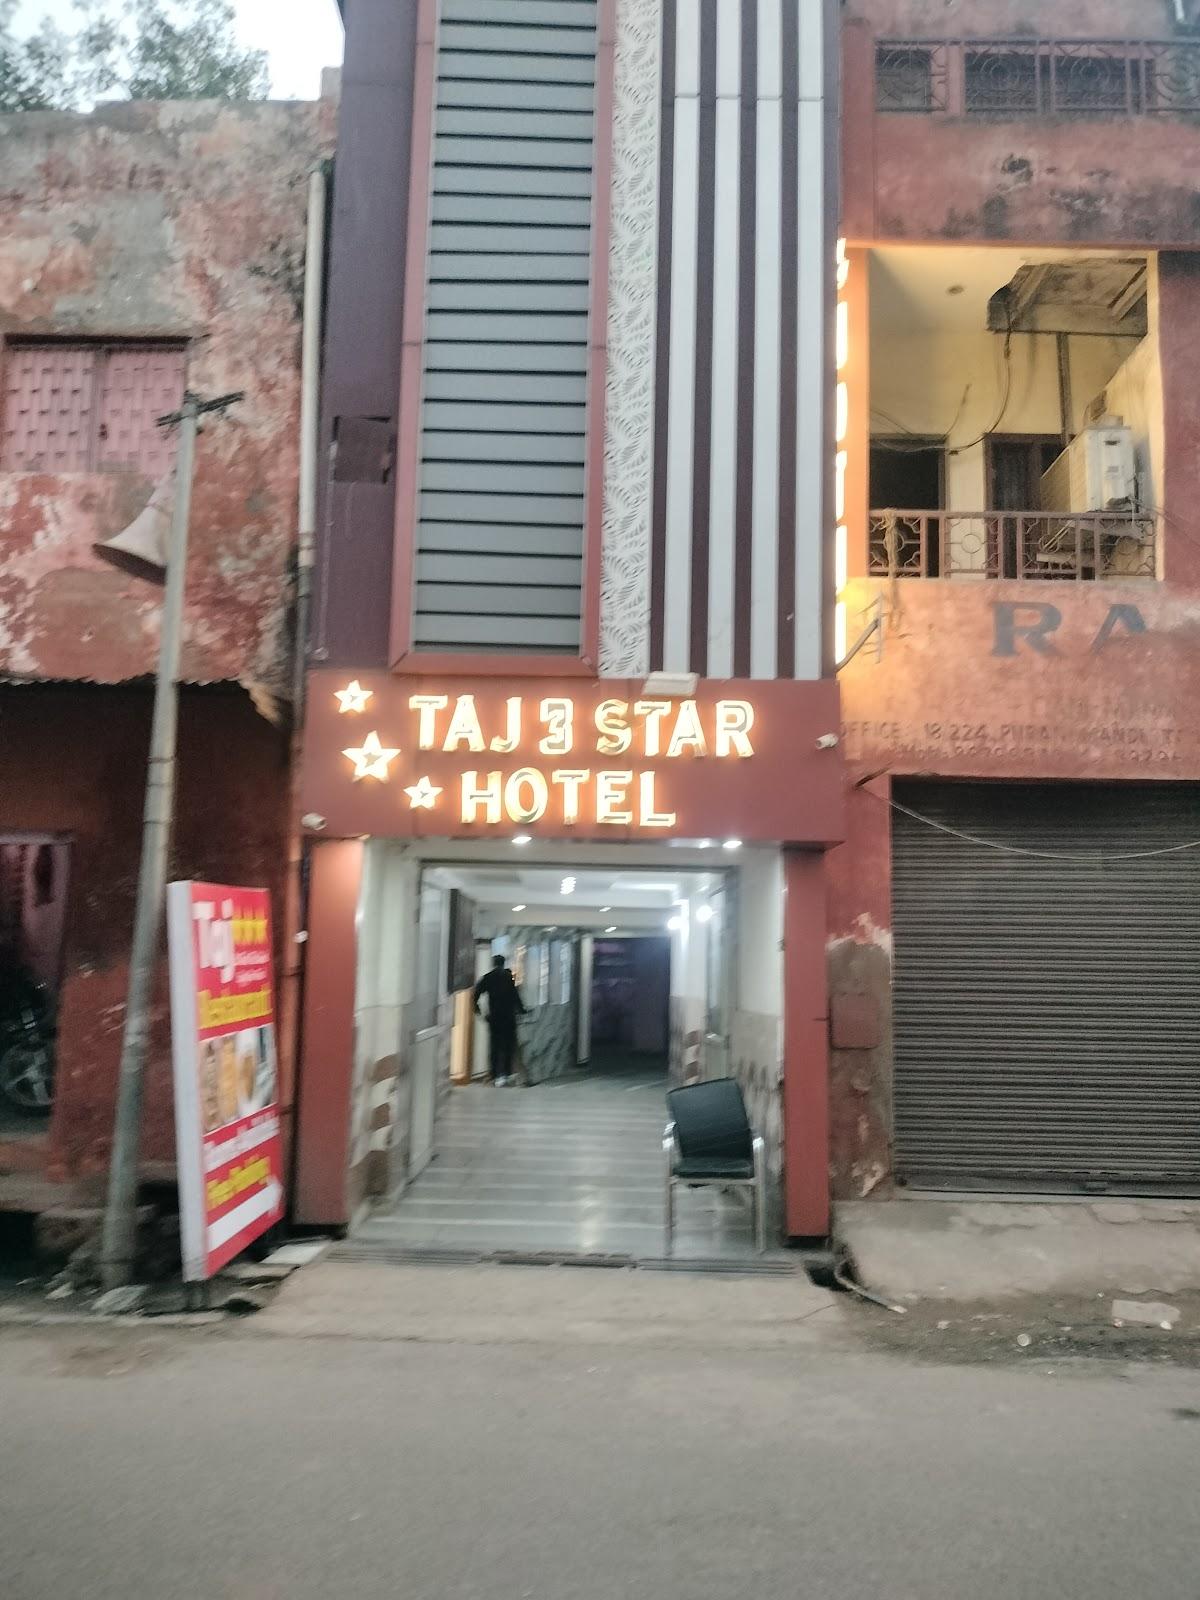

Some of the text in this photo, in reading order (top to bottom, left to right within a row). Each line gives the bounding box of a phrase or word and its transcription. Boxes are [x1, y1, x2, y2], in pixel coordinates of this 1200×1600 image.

[408, 694, 756, 758] TAJ 3 STAR
[460, 766, 677, 827] HOTEL
